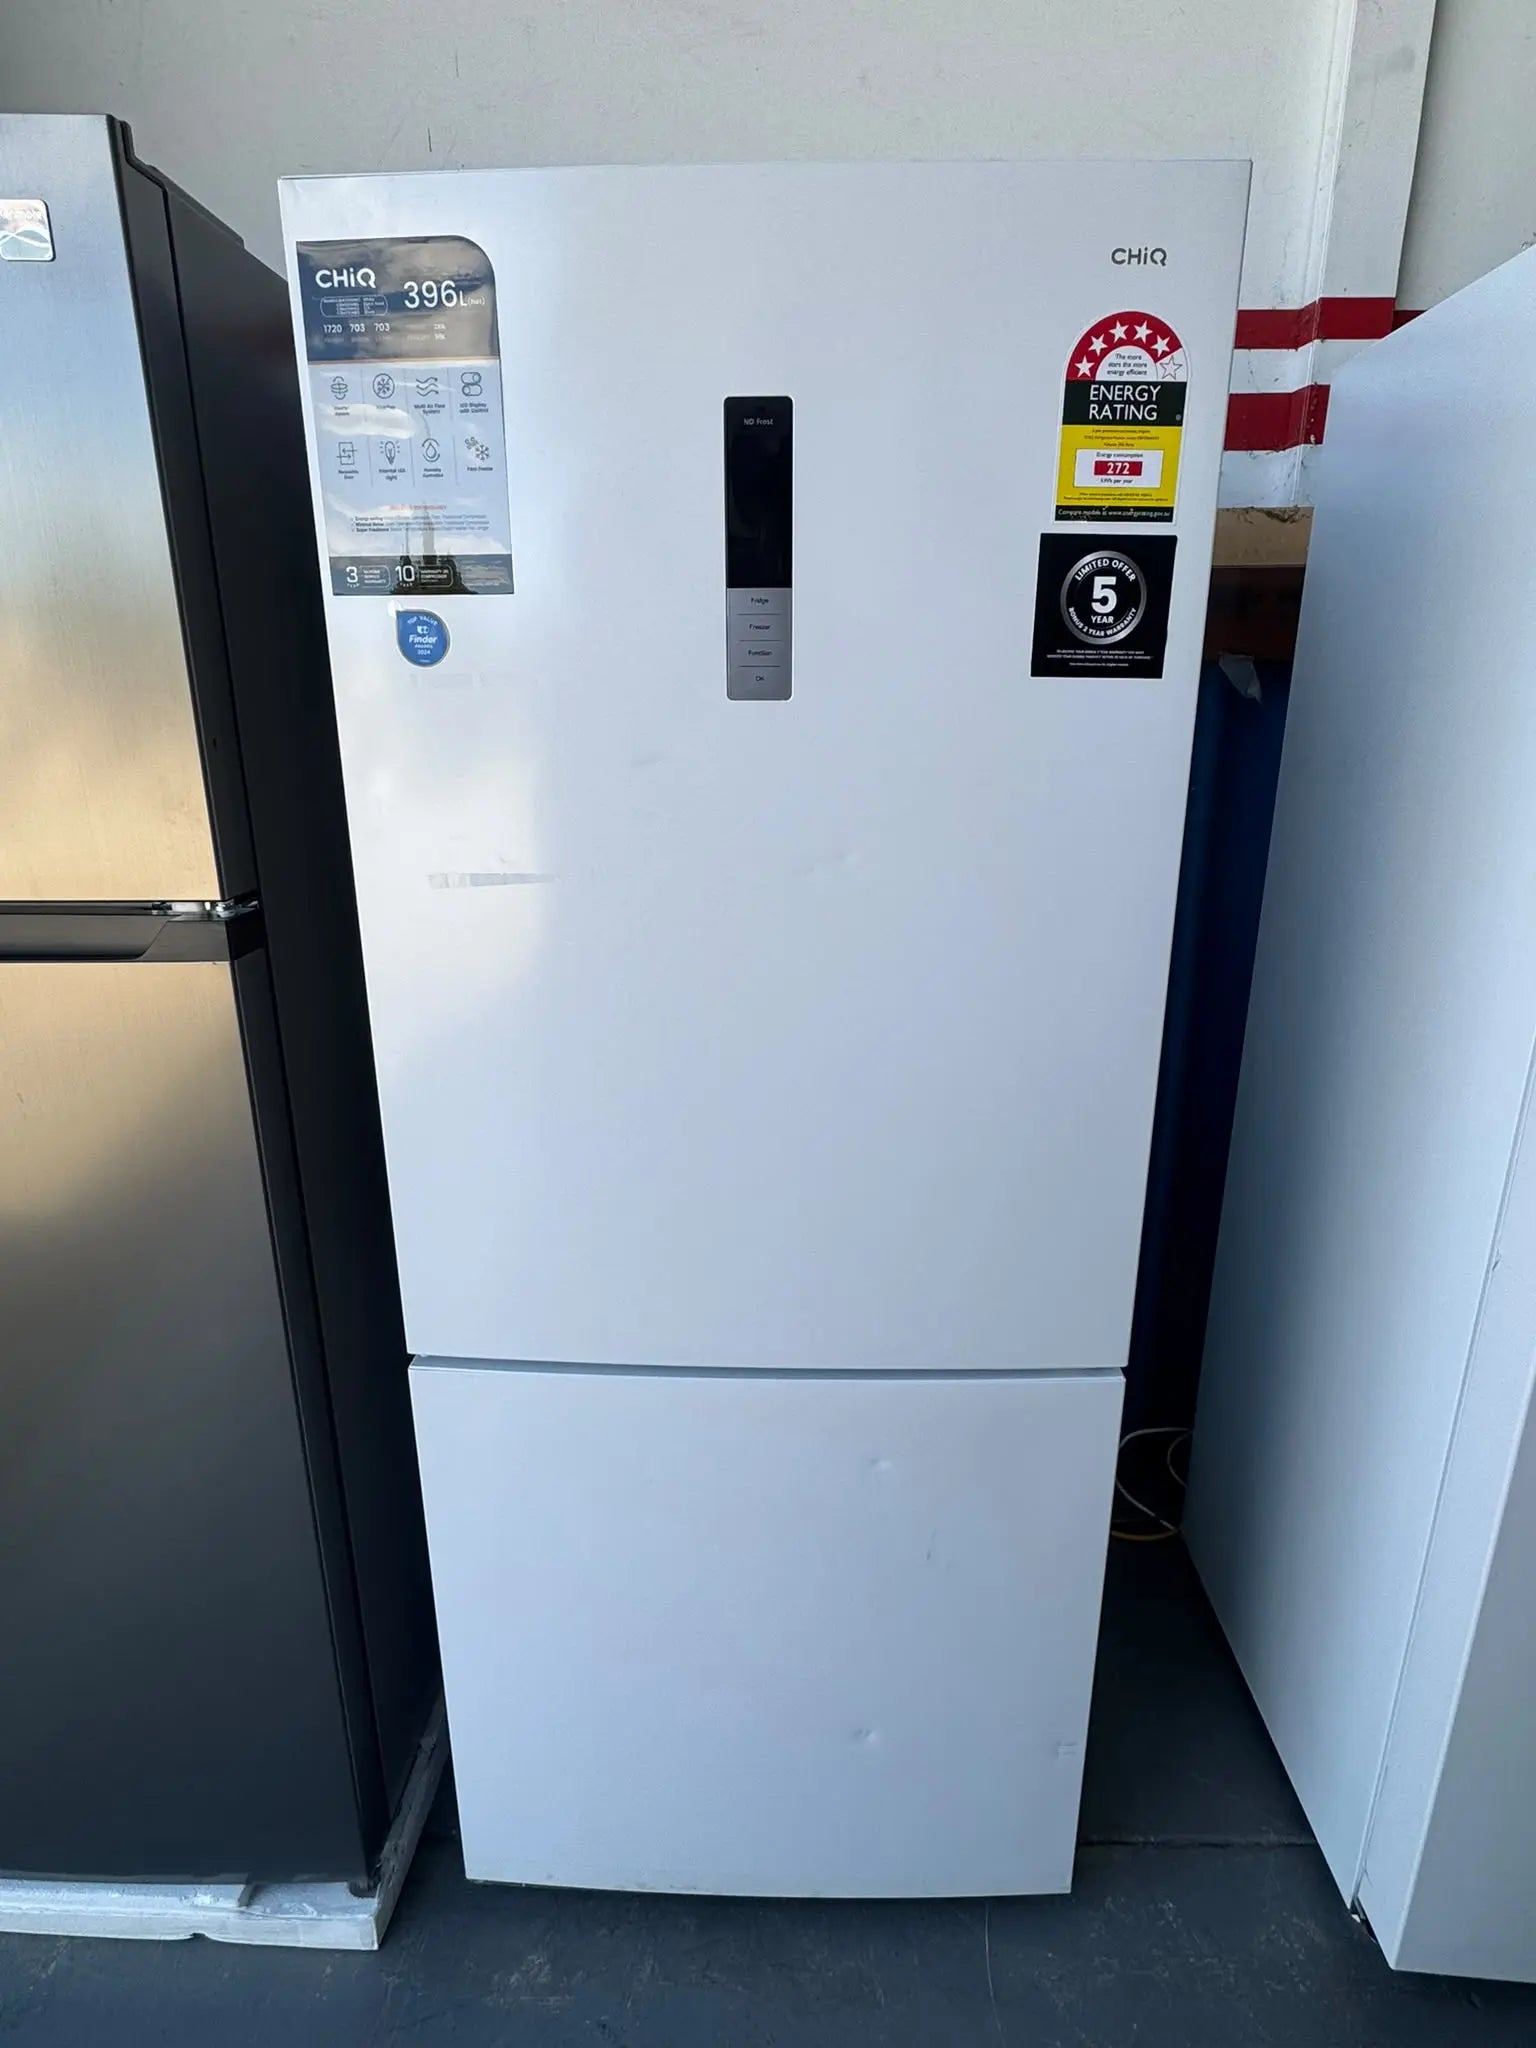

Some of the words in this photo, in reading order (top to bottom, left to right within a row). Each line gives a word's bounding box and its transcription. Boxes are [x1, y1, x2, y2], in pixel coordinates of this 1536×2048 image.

[1111, 247, 1167, 266] CHiQ
[315, 267, 376, 288] CHiQ
[323, 324, 342, 333] 1720
[350, 323, 365, 332] 703
[374, 322, 390, 332] 703
[1090, 385, 1161, 401] ENERGY
[1089, 404, 1158, 420] RATING
[756, 417, 773, 425] Frost
[1106, 462, 1130, 474] 272
[346, 566, 358, 583] 3
[395, 565, 415, 581] 10
[1075, 559, 1109, 581] LIMITED
[1112, 560, 1136, 582] OFFER
[750, 597, 769, 605] Fridge
[1091, 576, 1117, 614] 5
[1068, 606, 1084, 629] BONUS
[1089, 628, 1105, 636] YEAR
[1106, 607, 1137, 635] WARRANTY
[1091, 615, 1114, 623] YEAR
[409, 634, 438, 644] Finder
